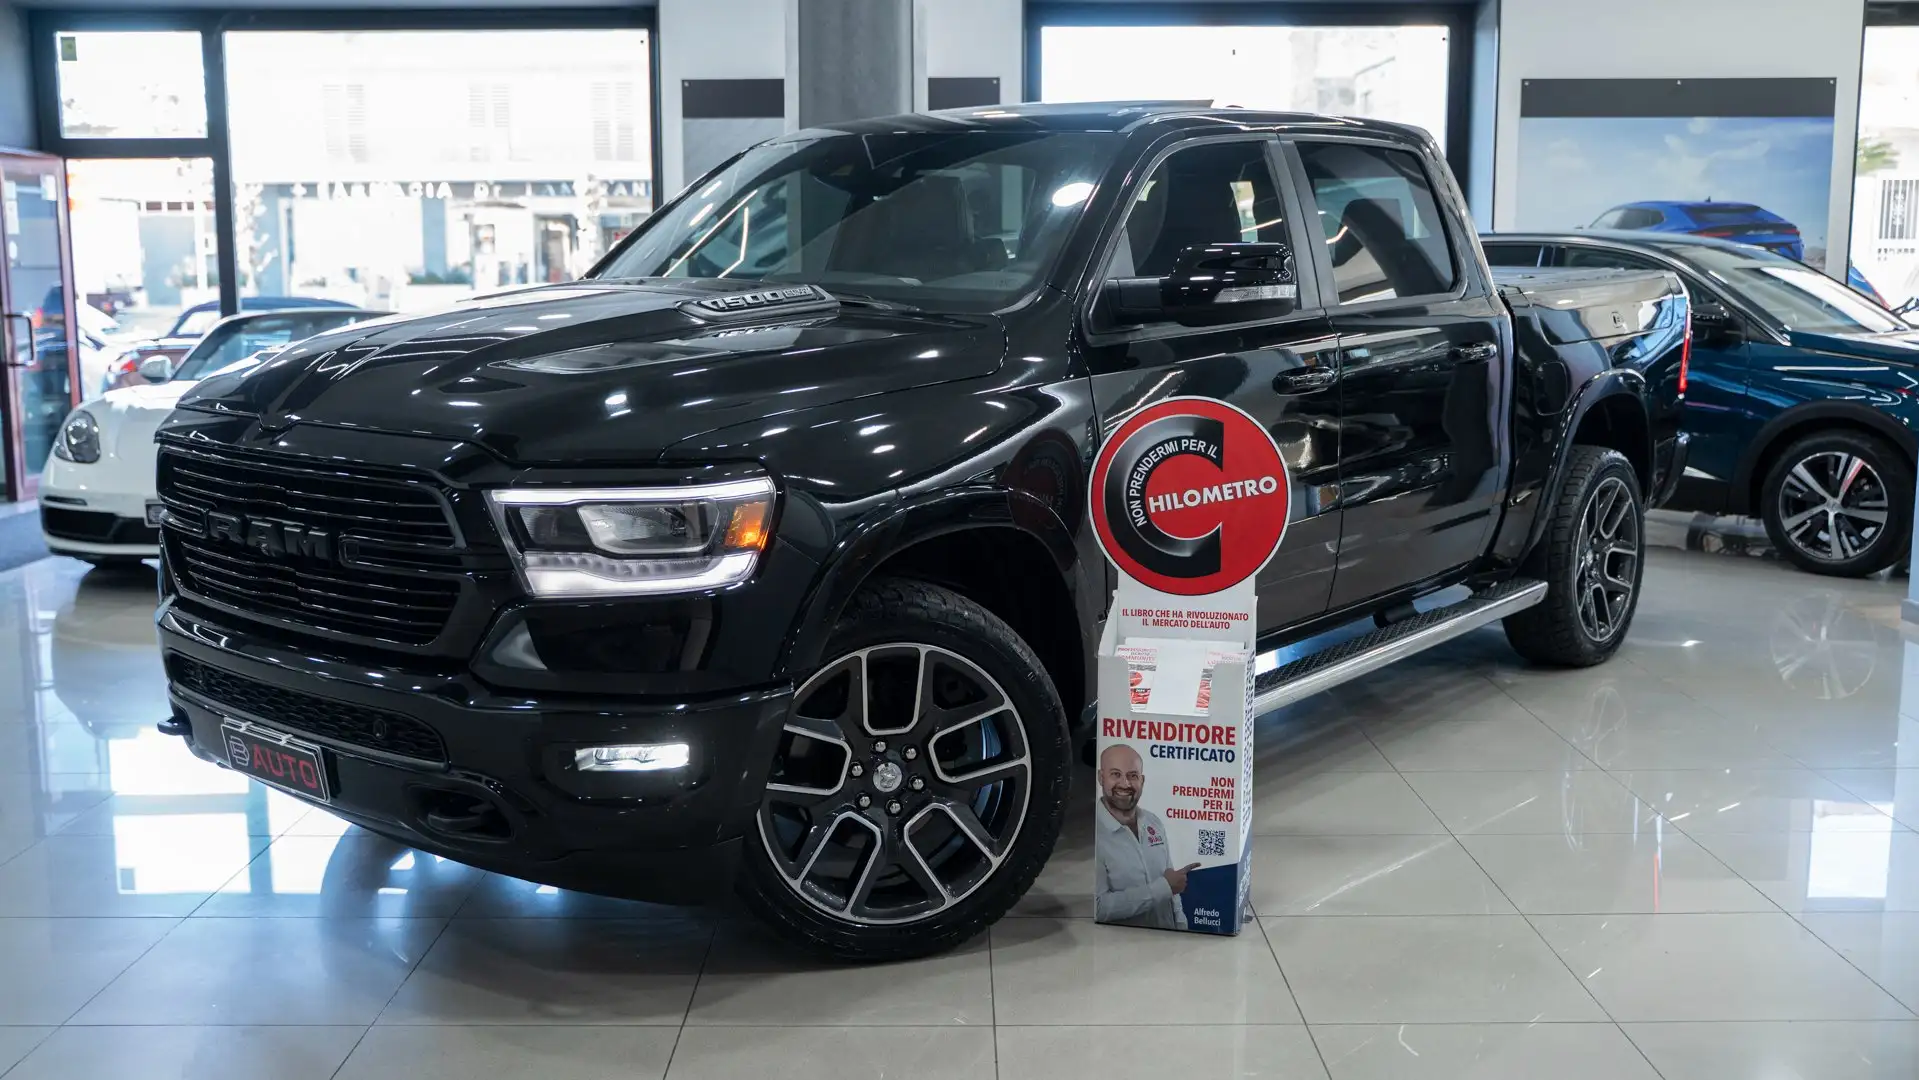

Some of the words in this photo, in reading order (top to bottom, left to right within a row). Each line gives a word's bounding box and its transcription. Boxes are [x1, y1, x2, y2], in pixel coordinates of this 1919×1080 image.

[701, 290, 784, 310] 1500
[1182, 439, 1205, 452] PER
[1207, 444, 1218, 459] IL
[1129, 441, 1179, 497] PRENDERMI
[1130, 500, 1147, 527] NON
[208, 510, 332, 561] RAM
[1122, 609, 1129, 617] IL
[1130, 609, 1154, 618] LIBRO
[1155, 609, 1171, 618] CHE
[1172, 610, 1184, 619] HA
[1186, 611, 1249, 621] RIVOLUZIONATO
[1152, 619, 1189, 628] MERCATO
[1190, 620, 1231, 630] DELL'AUTO
[1102, 717, 1236, 746] RIVENDITORE
[1149, 744, 1236, 763] CERTIFICATO
[252, 743, 318, 789] AUTO
[1210, 777, 1235, 788] NON
[1172, 785, 1235, 799] PRENDERMI
[1203, 799, 1224, 811] PER
[1225, 801, 1235, 811] IL
[1165, 807, 1234, 823] CHILOMETRO
[1193, 907, 1220, 918] Alfredo
[1194, 917, 1221, 927] Bellucci
